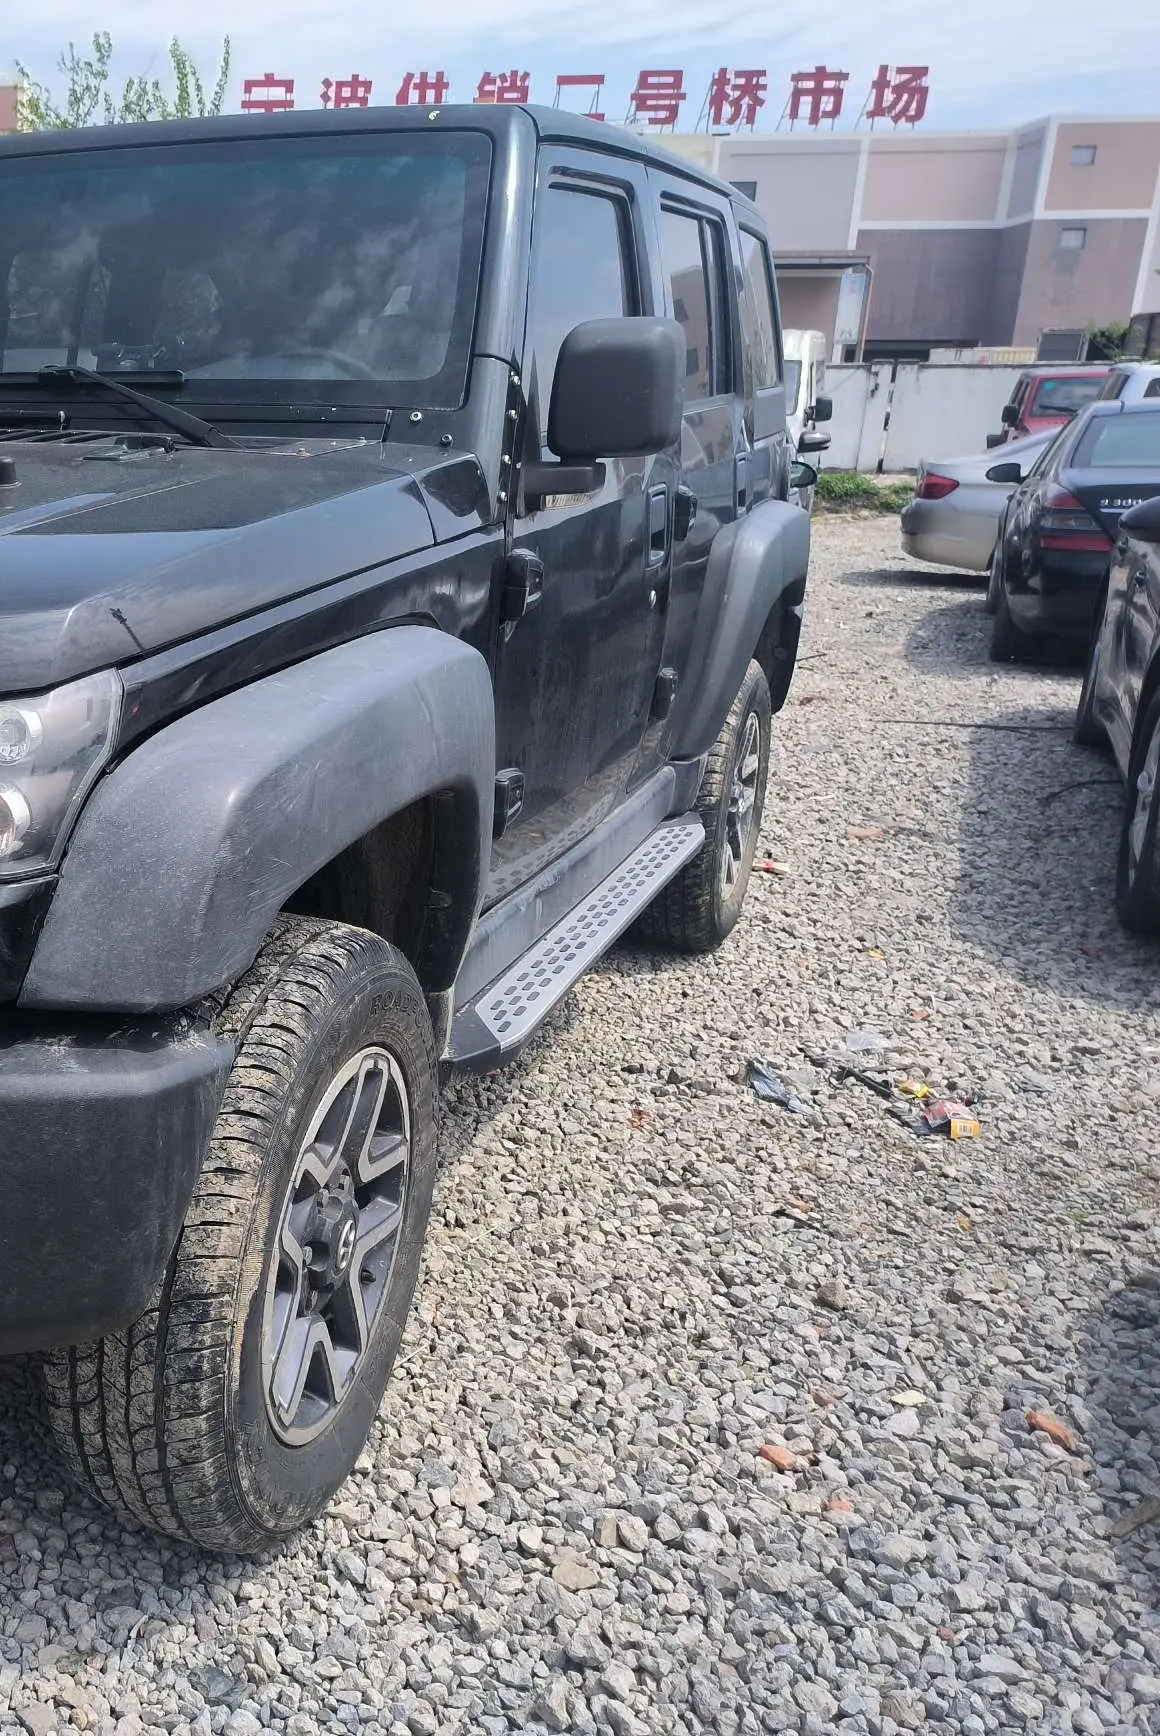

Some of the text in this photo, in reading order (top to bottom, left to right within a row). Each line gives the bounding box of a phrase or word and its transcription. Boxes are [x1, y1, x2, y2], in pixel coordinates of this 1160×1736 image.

[240, 64, 930, 127] 宁波供销二号桥市场
